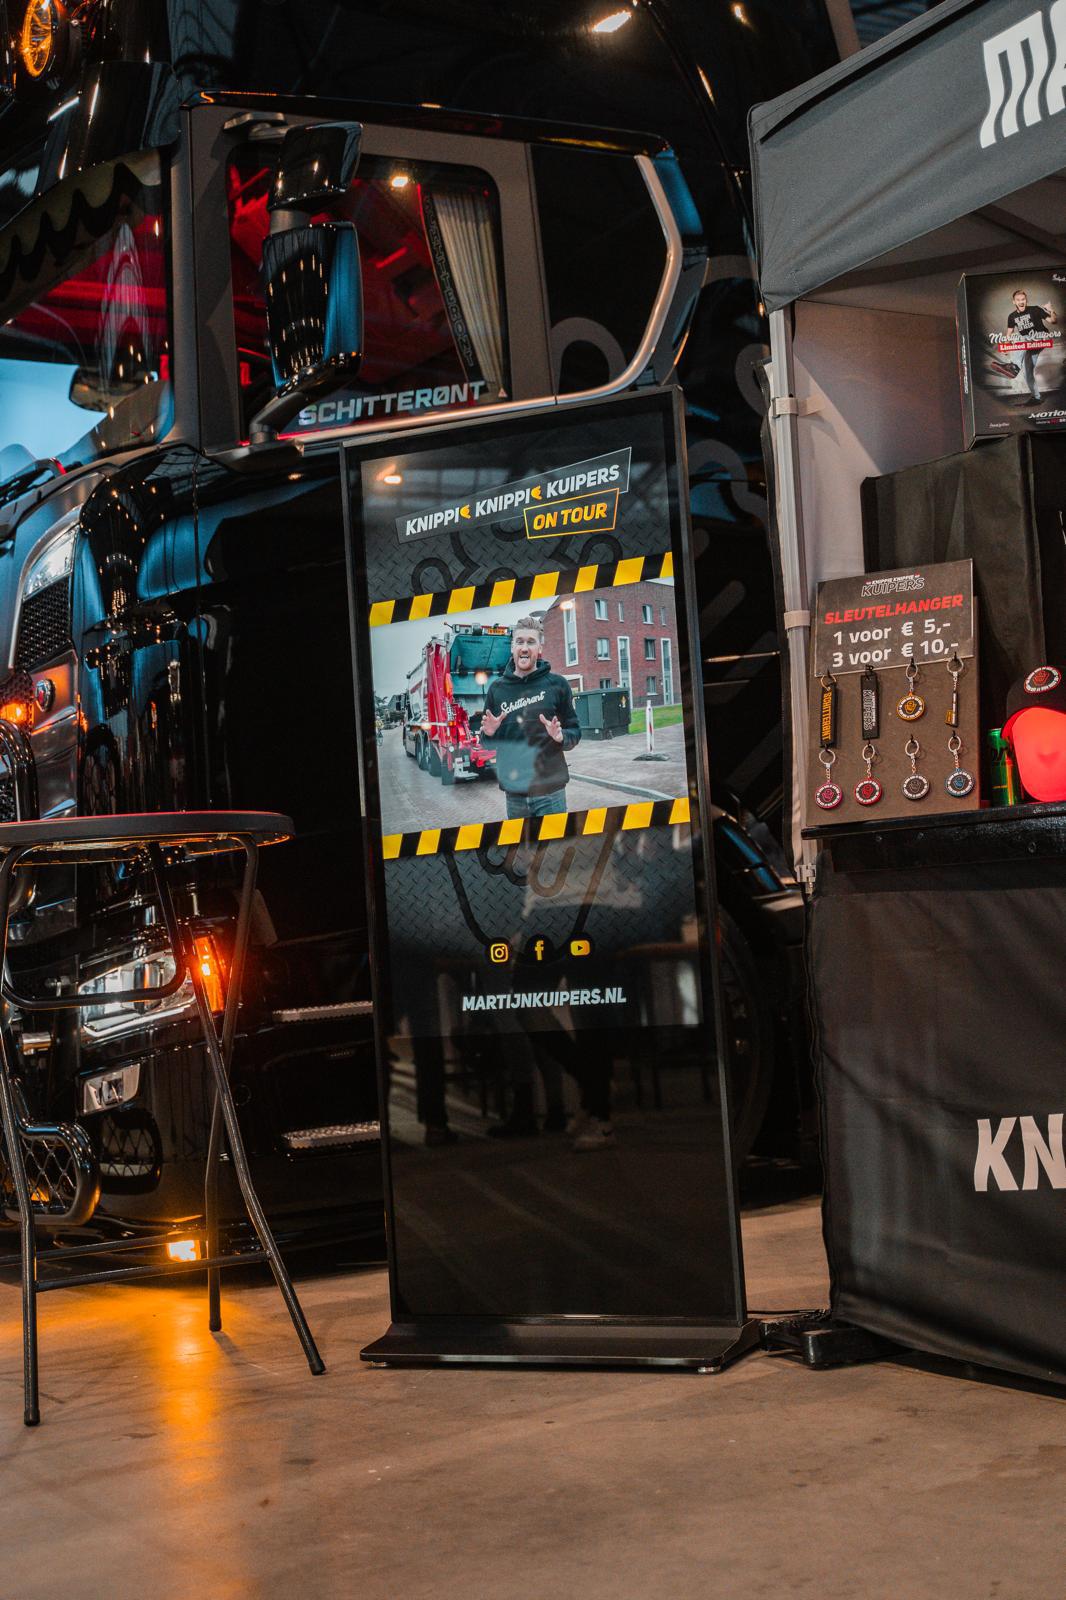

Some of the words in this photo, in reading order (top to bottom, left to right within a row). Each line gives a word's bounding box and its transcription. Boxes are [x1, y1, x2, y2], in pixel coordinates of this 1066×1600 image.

[1000, 343, 1026, 351] Limited
[1026, 341, 1051, 349] Edition
[298, 381, 485, 426] SCHITTERØNT
[546, 464, 620, 498] KUIPERS
[533, 511, 558, 531] ON
[560, 502, 608, 527] TOUR
[861, 578, 925, 597] KUIPERS
[824, 594, 963, 625] SLEUTELHANGER
[833, 631, 842, 645] 1
[849, 627, 892, 644] voor
[832, 652, 844, 668] 3
[849, 647, 892, 665] voor
[462, 987, 627, 1011] MARTIJNKUIPERS.NL
